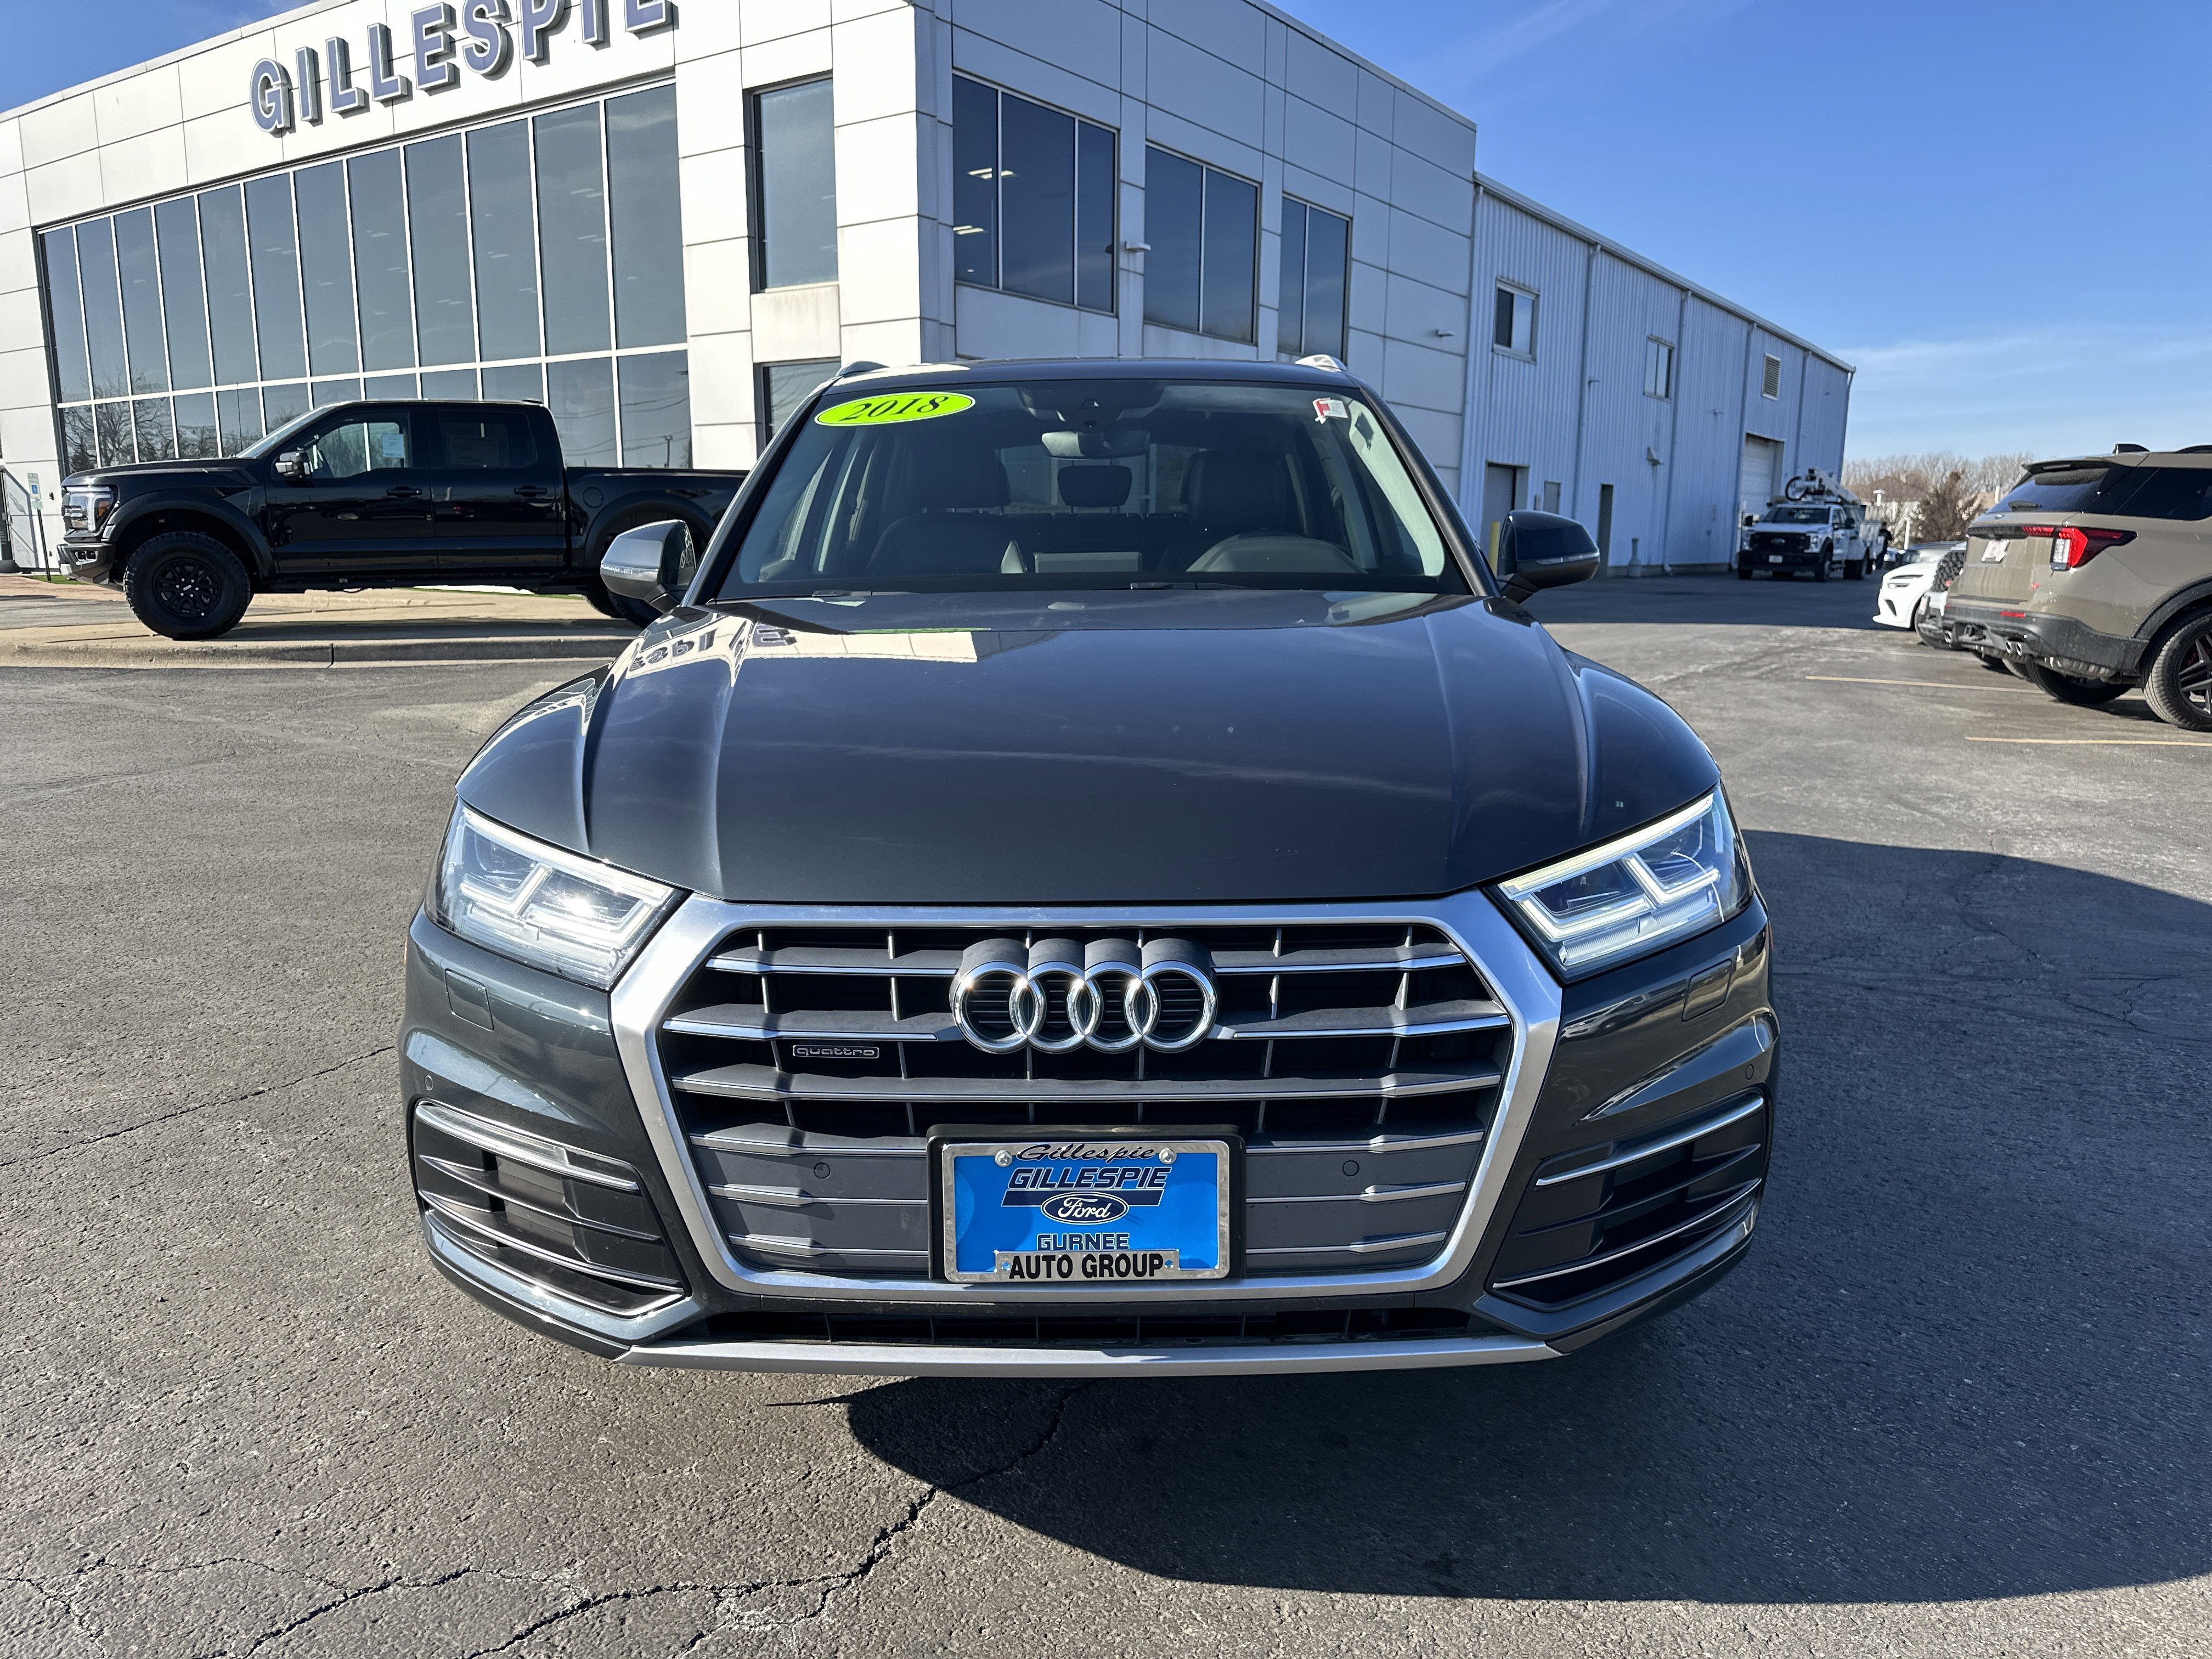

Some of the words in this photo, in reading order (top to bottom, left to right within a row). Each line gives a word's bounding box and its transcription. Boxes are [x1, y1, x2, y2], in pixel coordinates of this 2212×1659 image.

[838, 396, 949, 421] 2018
[797, 1047, 874, 1056] quattro
[1017, 1144, 1155, 1164] Gillespie
[1007, 1167, 1172, 1189] GILLESPIE
[1058, 1197, 1111, 1219] Ford
[1036, 1233, 1130, 1251] GURNEE
[1008, 1254, 1073, 1279] AUTO
[1081, 1252, 1164, 1278] GROUP
